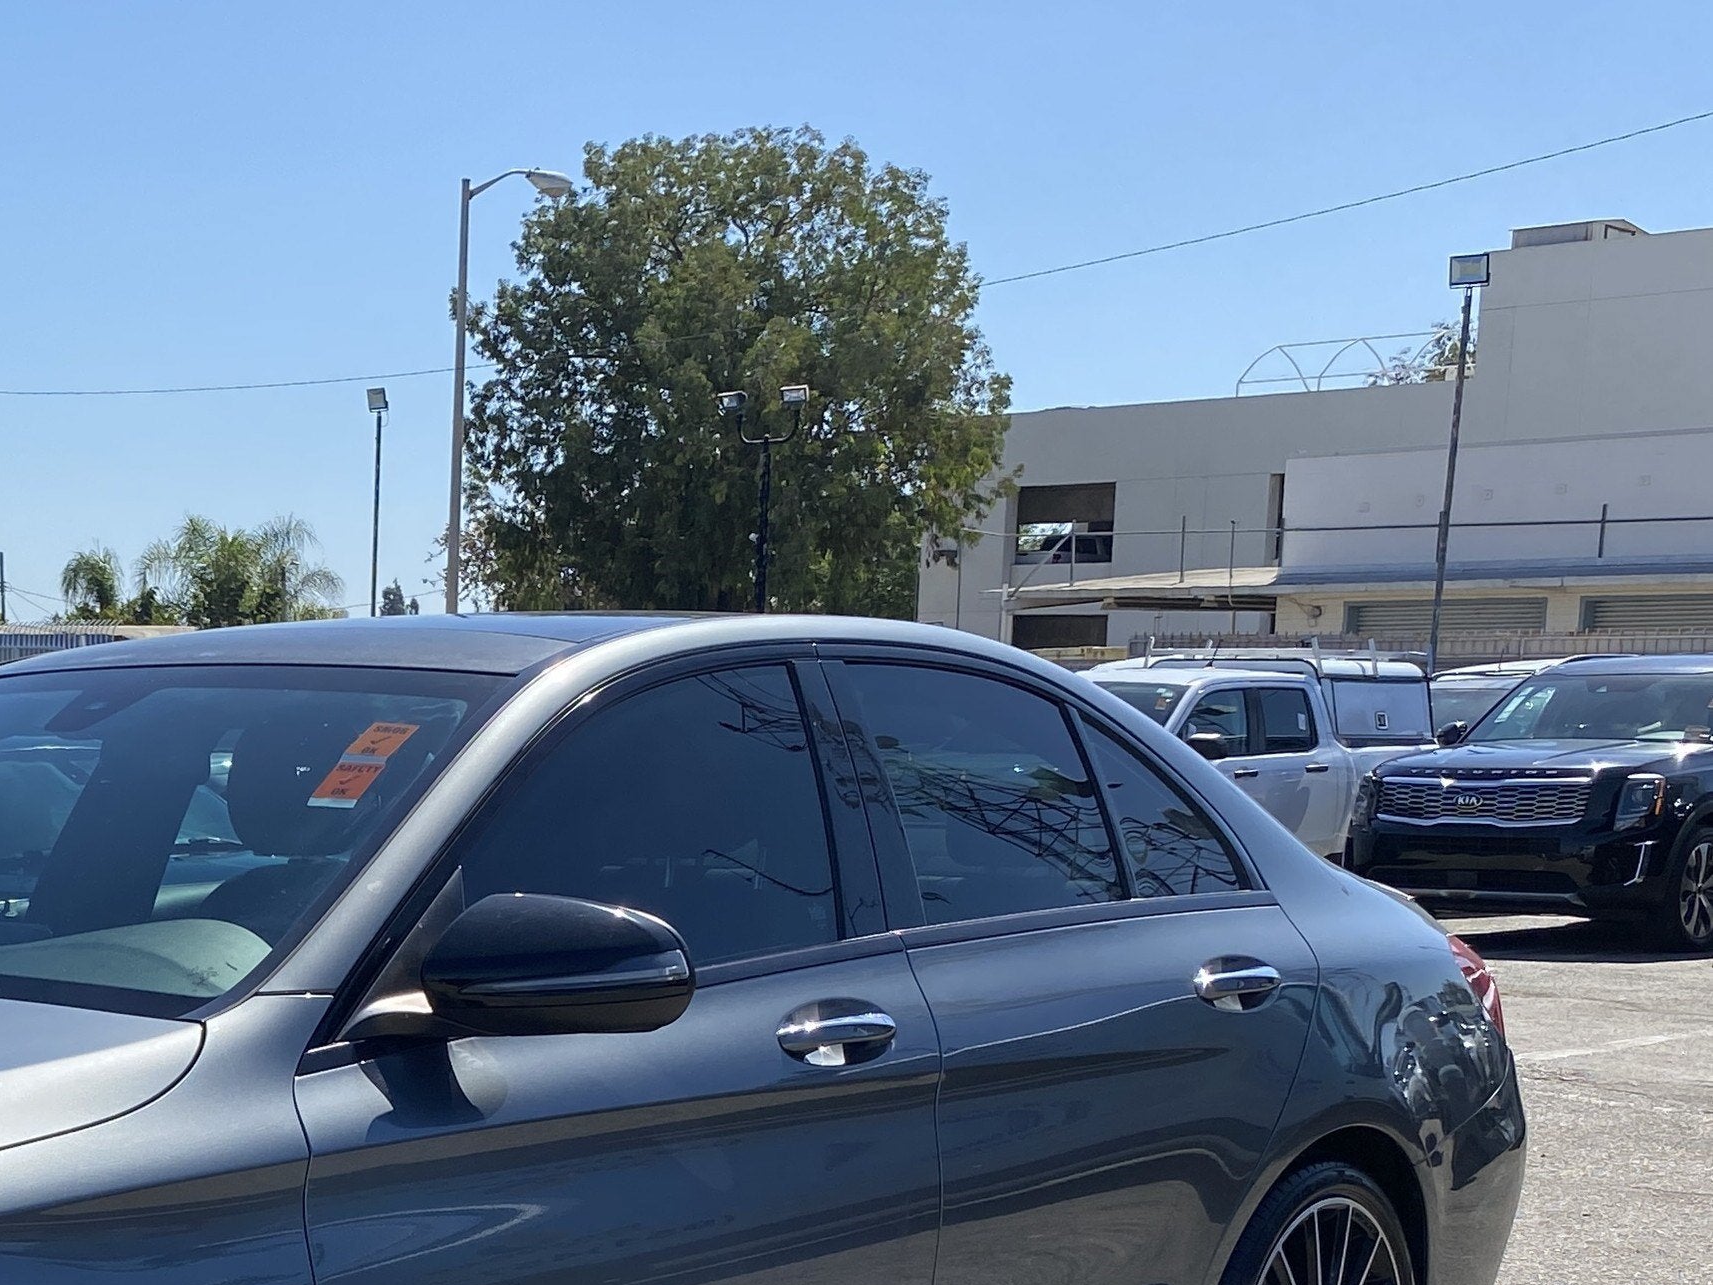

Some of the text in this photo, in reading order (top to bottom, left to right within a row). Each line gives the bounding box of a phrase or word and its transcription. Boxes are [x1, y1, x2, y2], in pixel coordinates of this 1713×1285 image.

[373, 726, 409, 734] SMOG
[362, 747, 377, 755] OK
[336, 764, 380, 773] SAFETY
[330, 788, 349, 796] OK
[1457, 795, 1478, 805] KIA
